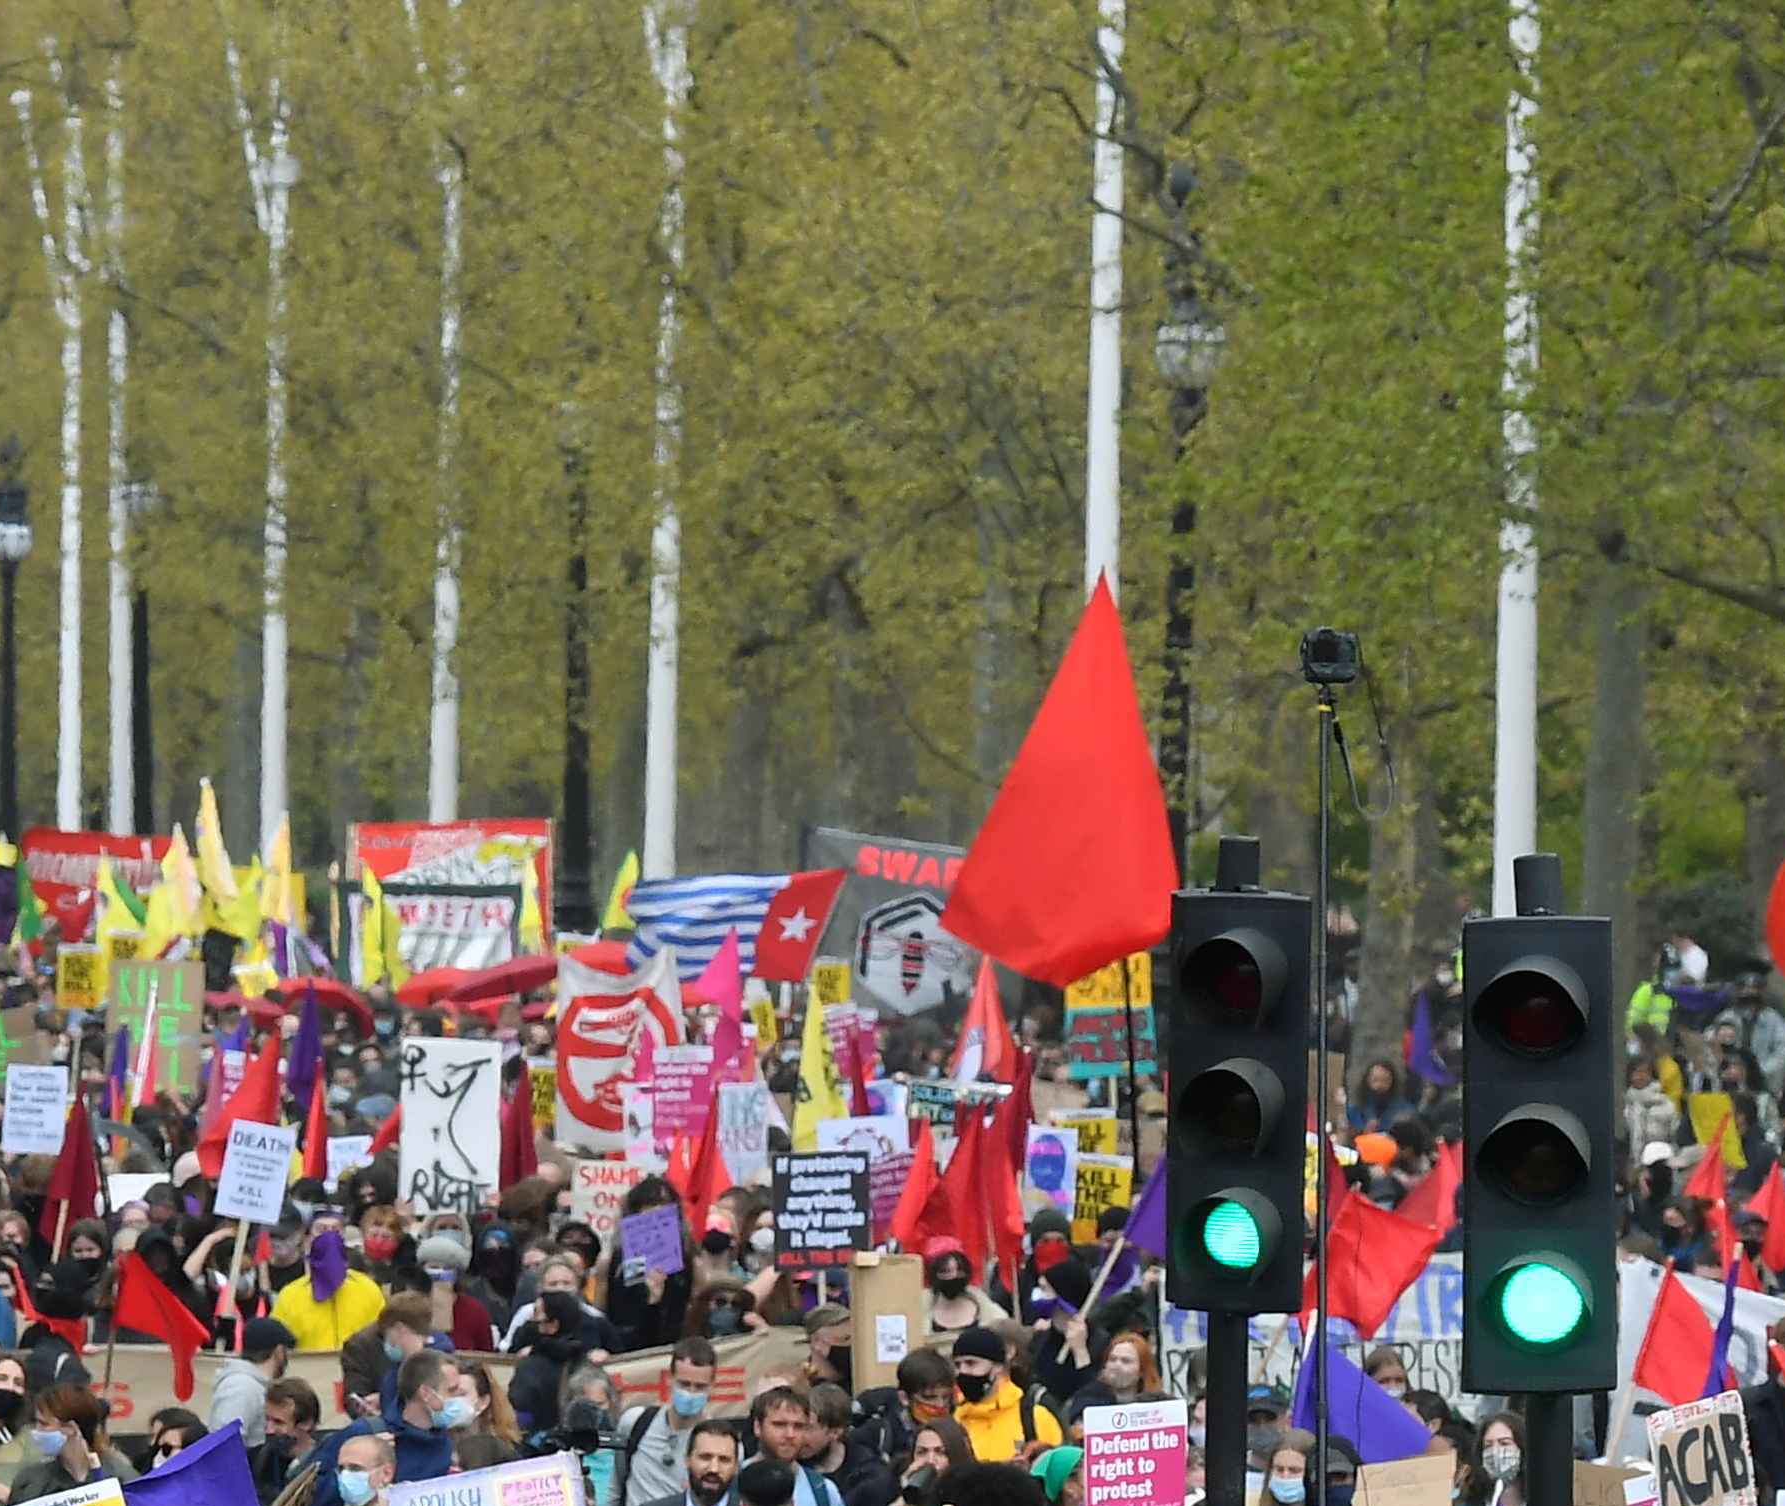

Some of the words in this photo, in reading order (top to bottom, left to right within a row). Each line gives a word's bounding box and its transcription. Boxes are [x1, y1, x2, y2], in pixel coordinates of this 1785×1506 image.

[790, 1156, 865, 1175] protesting
[790, 1174, 852, 1192] changed
[1090, 1436, 1150, 1455] Defend
[1151, 1430, 1179, 1449] the
[1090, 1459, 1135, 1481] right
[1136, 1456, 1156, 1474] to
[1091, 1480, 1153, 1506] protest
